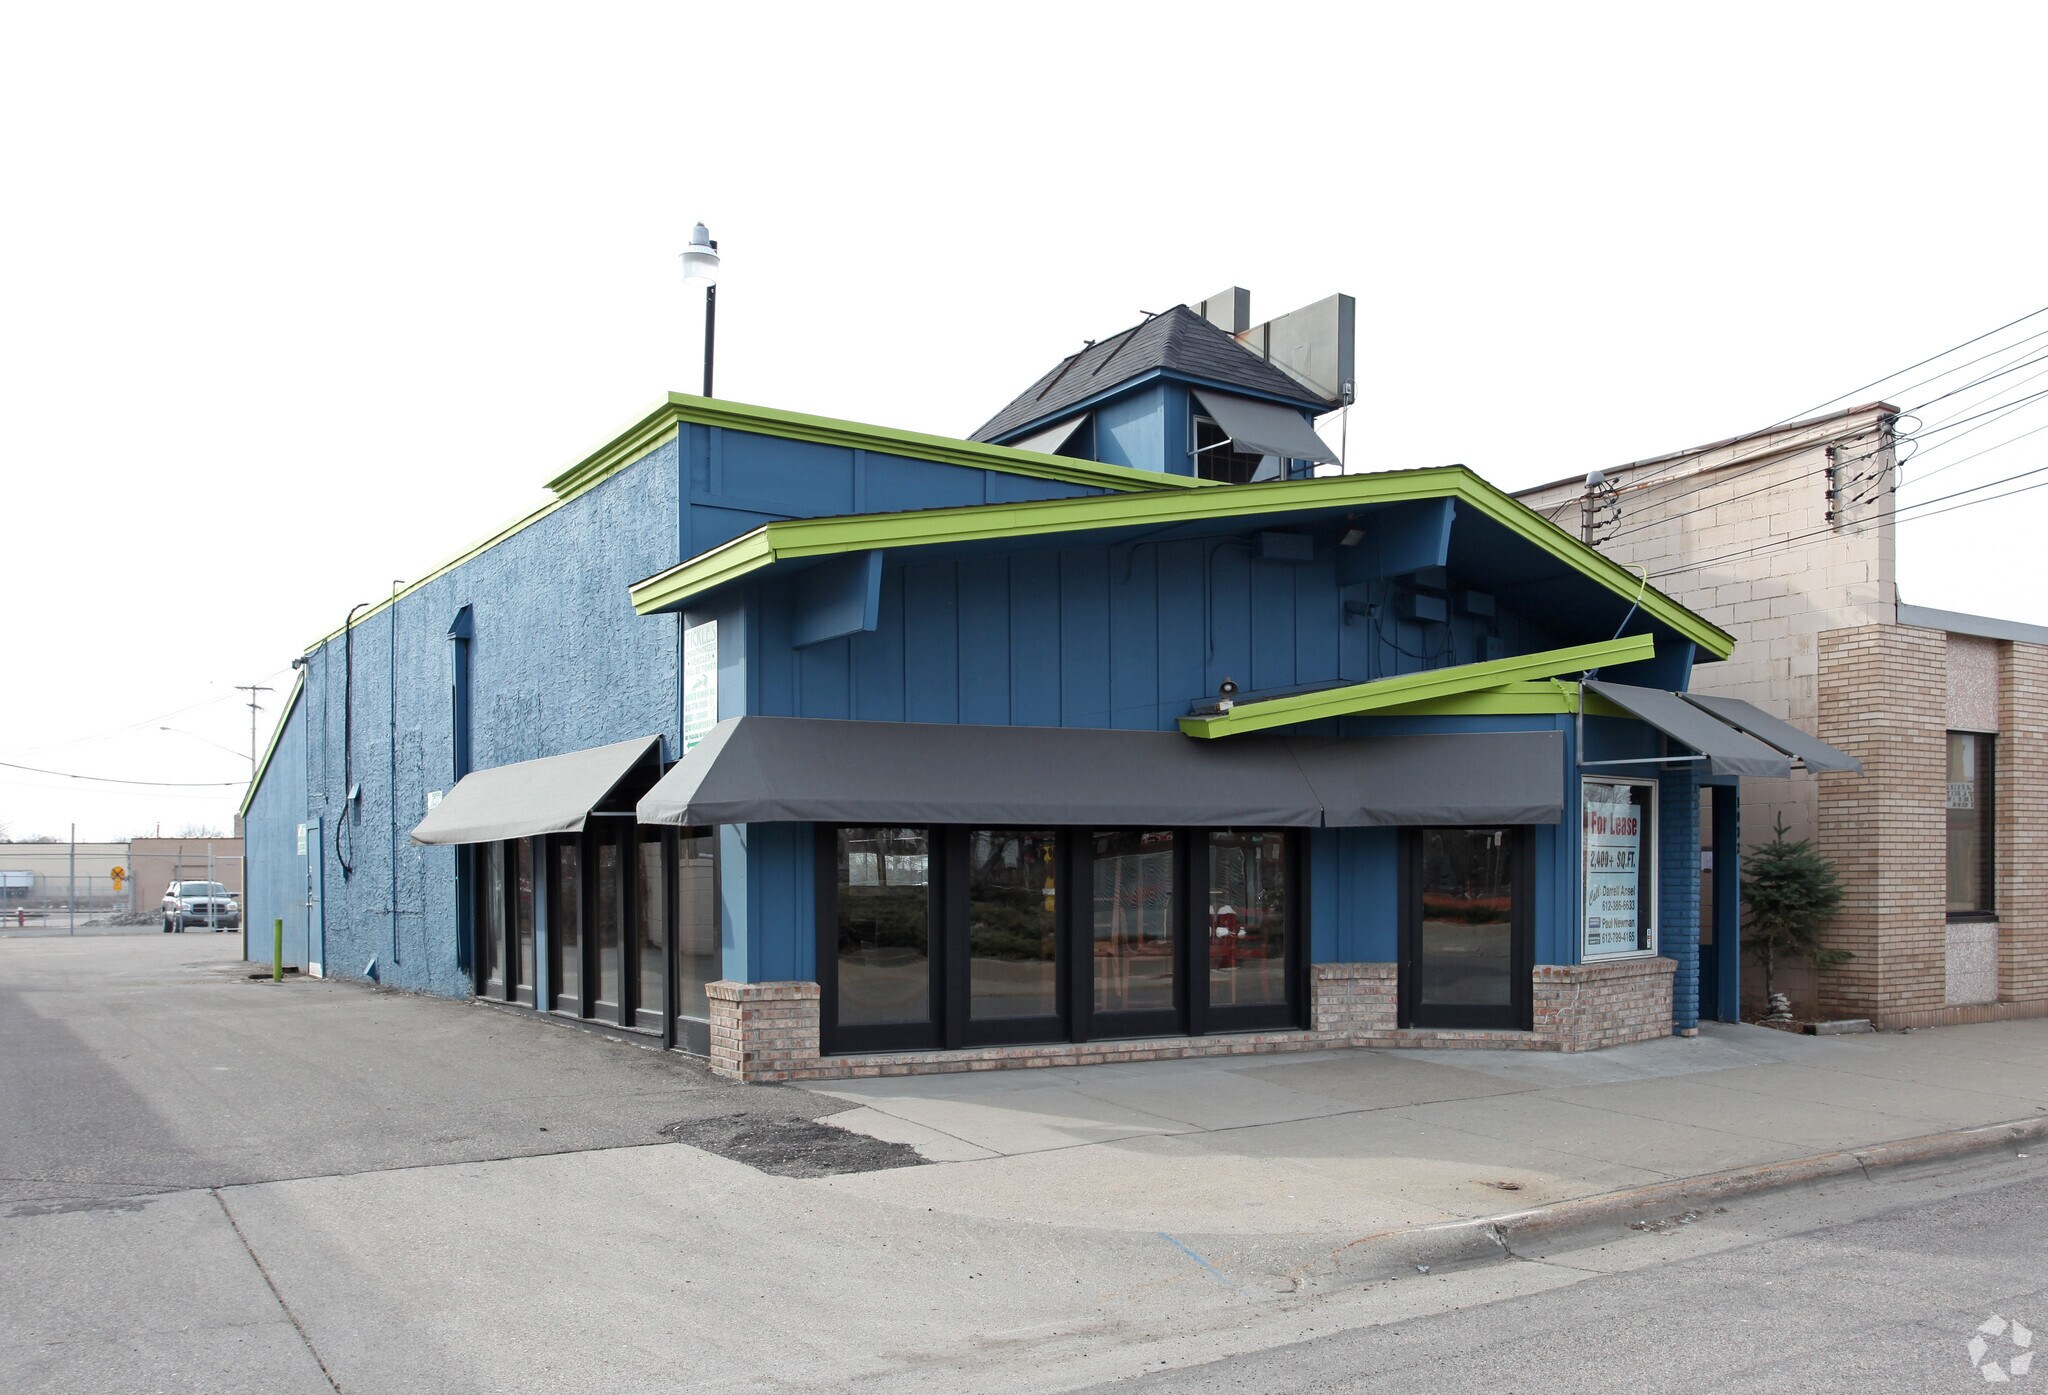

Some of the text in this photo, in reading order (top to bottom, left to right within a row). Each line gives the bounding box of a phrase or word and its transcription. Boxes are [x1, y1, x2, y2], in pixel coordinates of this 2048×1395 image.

[1591, 811, 1638, 836] For Lease
[1590, 851, 1614, 869] 2,400+
[1602, 885, 1620, 897] Darrell
[1621, 885, 1636, 897] Ansel
[1601, 918, 1613, 929] Paul
[1613, 917, 1636, 929] Newman
